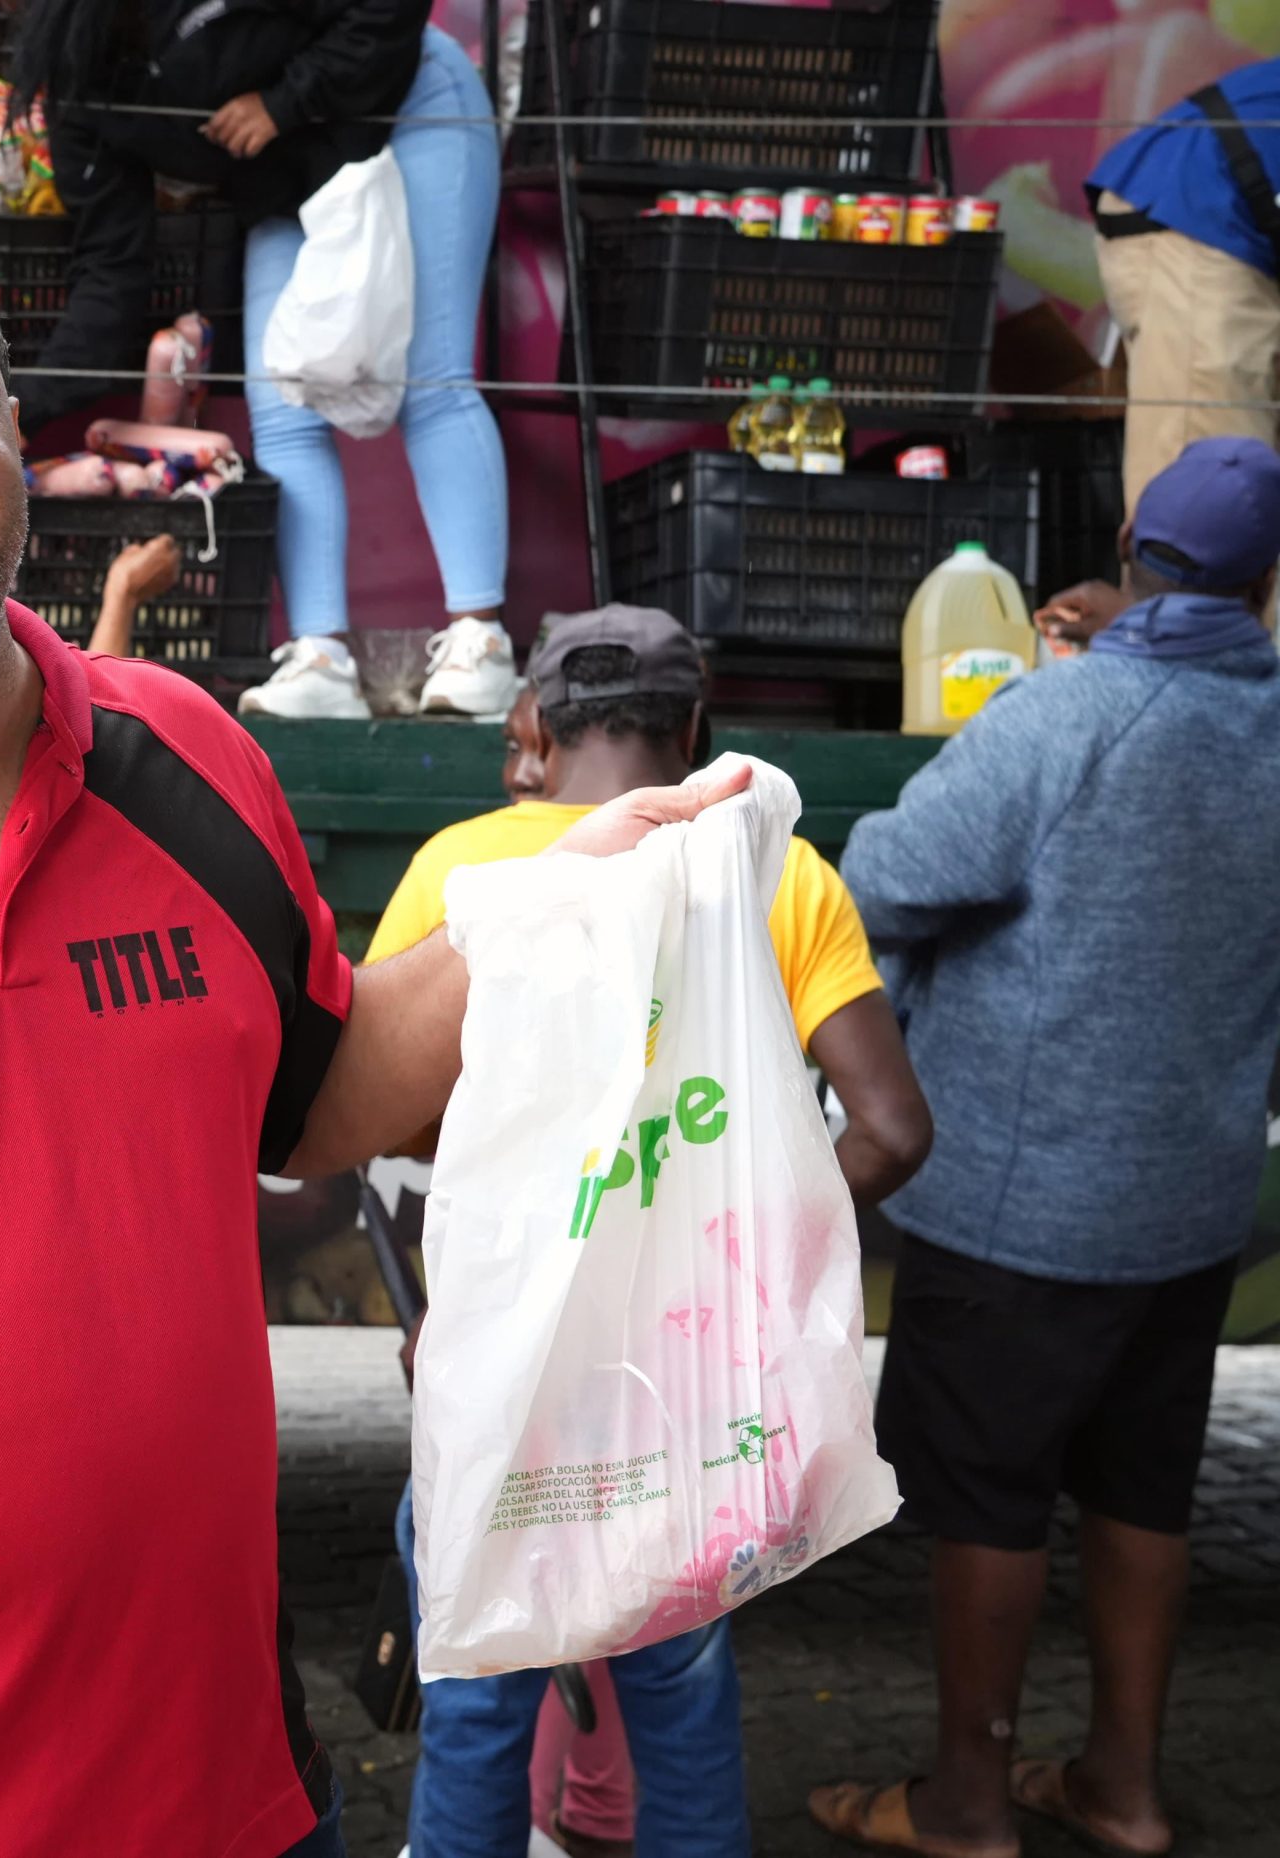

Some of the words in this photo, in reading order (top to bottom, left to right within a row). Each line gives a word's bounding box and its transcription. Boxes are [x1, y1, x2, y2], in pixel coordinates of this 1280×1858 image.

[66, 925, 209, 1013] TITLE
[534, 1466, 555, 1478] ESTA
[557, 1464, 591, 1475] BOLSA
[591, 1463, 603, 1473] NO
[626, 1449, 669, 1468] JUGUETE
[702, 1453, 740, 1470] Reciclar
[500, 1481, 536, 1495] CAUSAR
[524, 1491, 552, 1504] FUERA
[554, 1488, 574, 1499] DEL
[625, 1481, 645, 1493] LOS
[501, 1509, 509, 1518] O
[541, 1502, 557, 1513] NO
[558, 1500, 571, 1511] LA
[573, 1500, 593, 1510] USE
[637, 1487, 671, 1503] CAMAS
[509, 1520, 517, 1529] Y
[518, 1514, 564, 1528] CORRALES
[565, 1512, 579, 1522] DE
